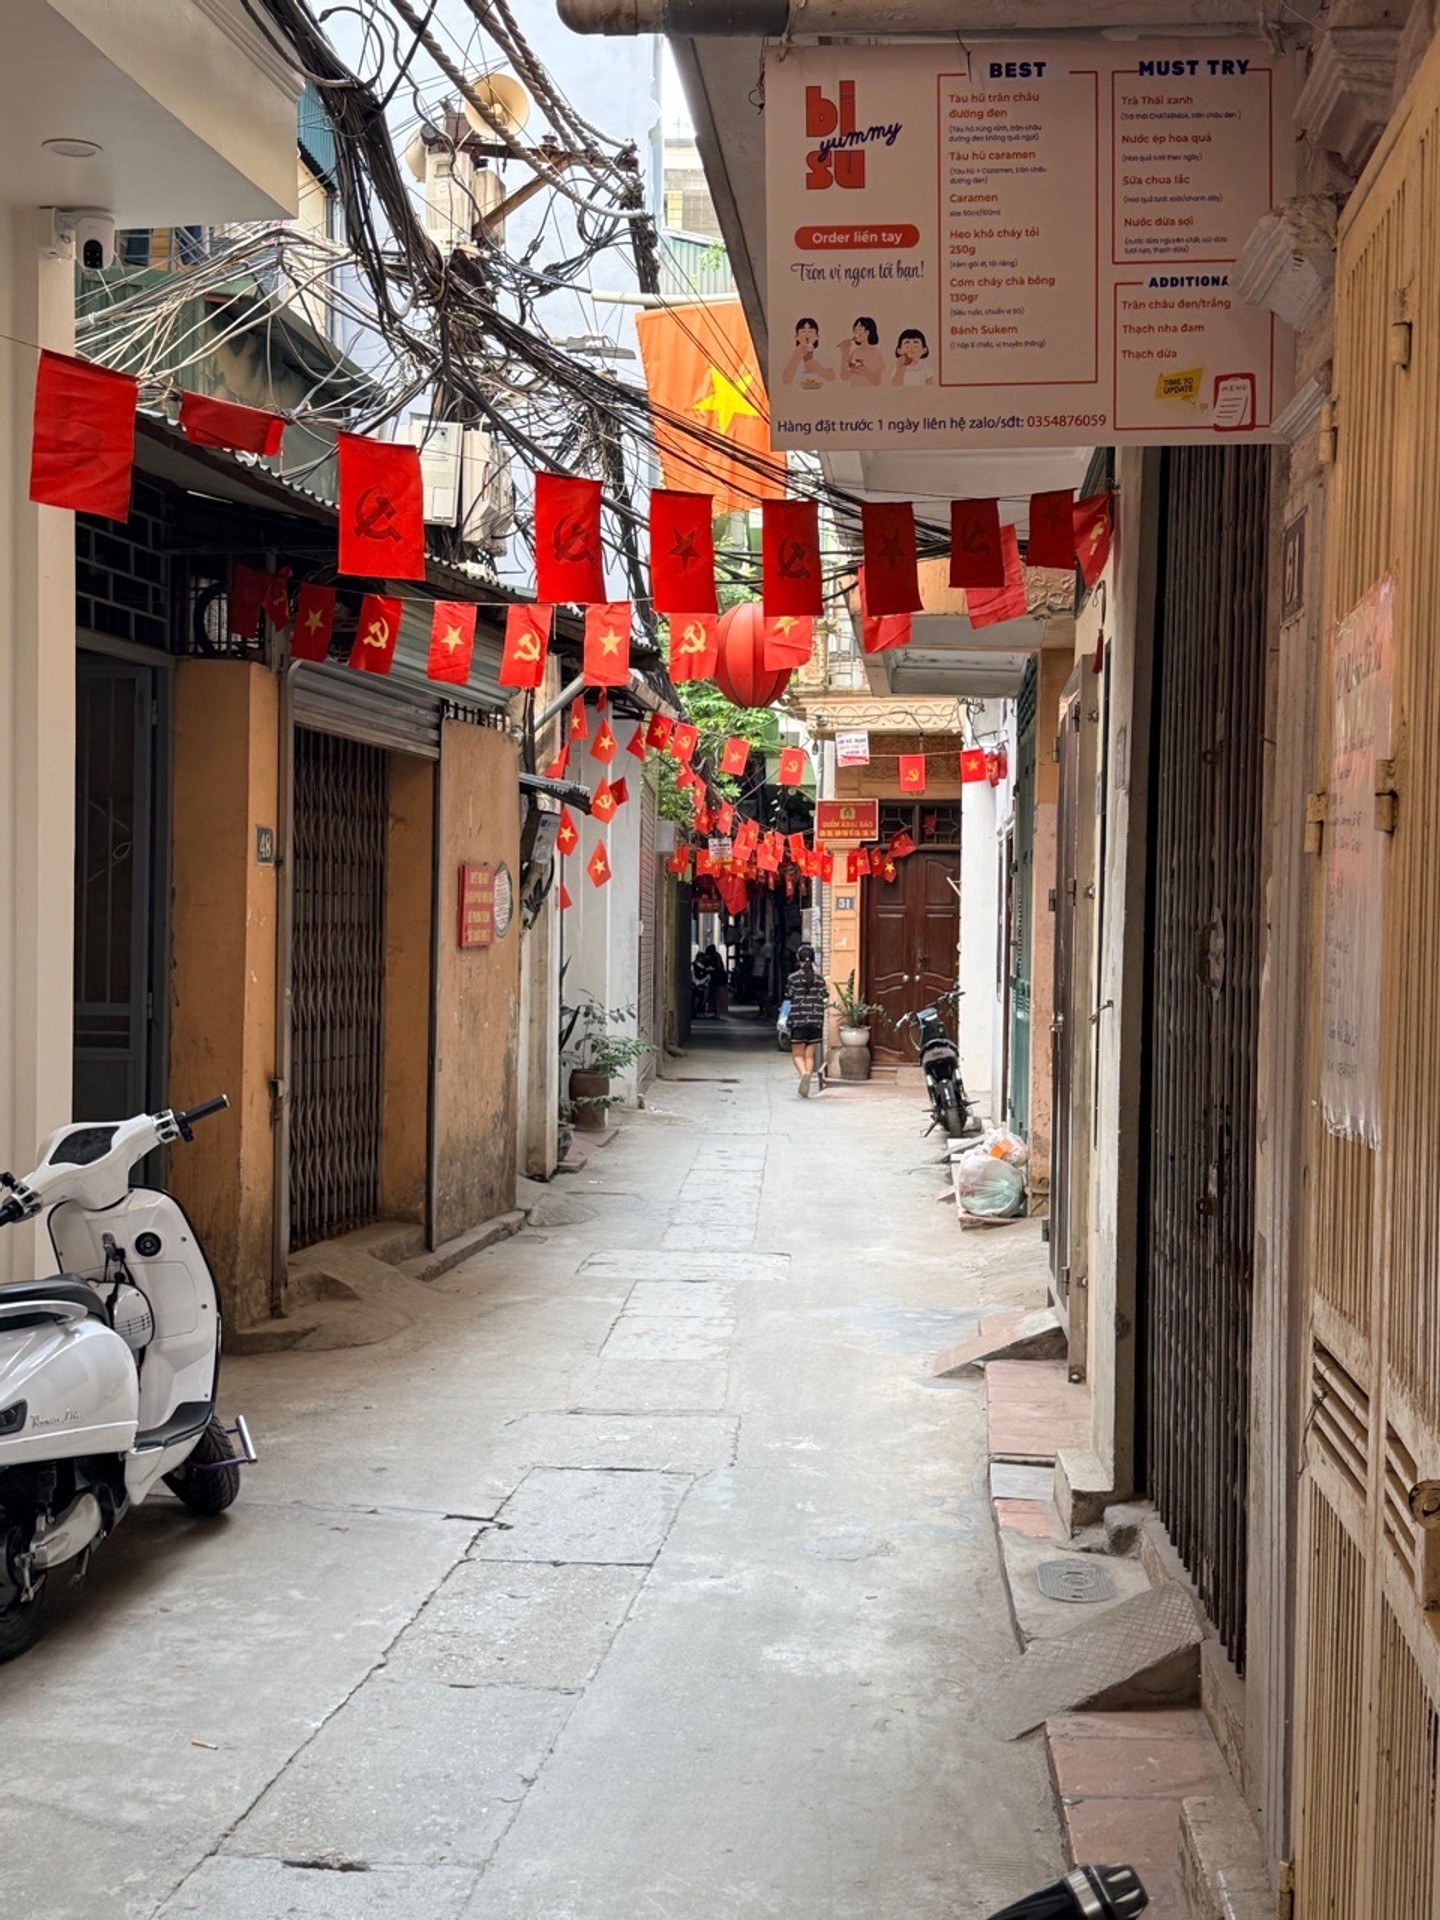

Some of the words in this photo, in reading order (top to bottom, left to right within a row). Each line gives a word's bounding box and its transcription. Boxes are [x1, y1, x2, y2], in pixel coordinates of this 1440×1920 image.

[990, 62, 1046, 77] BEST
[1139, 61, 1199, 76] MUST
[1207, 60, 1249, 75] TRY
[988, 93, 1010, 102] trân
[1013, 92, 1039, 101] châu
[1122, 97, 1138, 105] Trà
[1142, 96, 1163, 104] Thái
[1167, 96, 1193, 104] xanh
[806, 80, 855, 137] bi
[949, 110, 984, 119] đường
[987, 109, 1007, 117] đen
[818, 122, 902, 162] yummy
[1122, 135, 1148, 143] Nước
[1152, 135, 1165, 144] ép
[1169, 134, 1188, 142] hoa
[1191, 133, 1211, 144] quả
[806, 150, 865, 189] su
[1123, 176, 1142, 185] Sữa
[1145, 175, 1171, 184] chua
[1175, 174, 1190, 184] lắc
[950, 193, 998, 203] Caramen
[1124, 218, 1151, 227] Nước
[1155, 217, 1175, 226] dừa
[1178, 216, 1193, 226] sợi
[812, 232, 849, 244] Order
[854, 231, 877, 243] liền
[882, 232, 902, 244] tay
[950, 231, 971, 239] Heo
[974, 230, 994, 238] khô
[997, 229, 1022, 239] cháy
[1025, 227, 1039, 236] tỏi
[950, 245, 976, 255] 250g
[791, 263, 825, 283] Trọn
[829, 263, 842, 283] vị
[844, 267, 875, 287] ngon
[879, 261, 893, 279] tới
[897, 260, 924, 281] bạn!
[950, 278, 974, 287] Cơm
[978, 278, 1002, 287] cháy
[1006, 277, 1024, 285] chà
[1028, 276, 1055, 286] bông
[1149, 276, 1229, 287] ADDITIONA
[951, 294, 978, 303] 130gr
[1122, 301, 1145, 310] Trân
[1149, 300, 1174, 309] châu
[1177, 299, 1231, 310] đen/trắng
[951, 326, 977, 335] Bánh
[981, 325, 1017, 334] Sukem
[1122, 325, 1154, 334] Thạch
[1158, 324, 1177, 332] nha
[1181, 323, 1204, 332] đam
[1122, 350, 1154, 360] Thạch
[1157, 349, 1177, 358] dừa
[1163, 378, 1182, 386] TIME
[1163, 385, 1193, 394] UPDATE
[778, 421, 811, 435] Hàng
[815, 419, 836, 434] đặt
[840, 419, 873, 431] trước
[878, 420, 882, 430] 1
[888, 418, 919, 433] ngày
[923, 418, 946, 430] liên
[950, 417, 966, 431] hệ
[969, 415, 1024, 429] zalo/sđt:
[1027, 414, 1106, 427] 0354876059
[839, 899, 850, 908] 51
